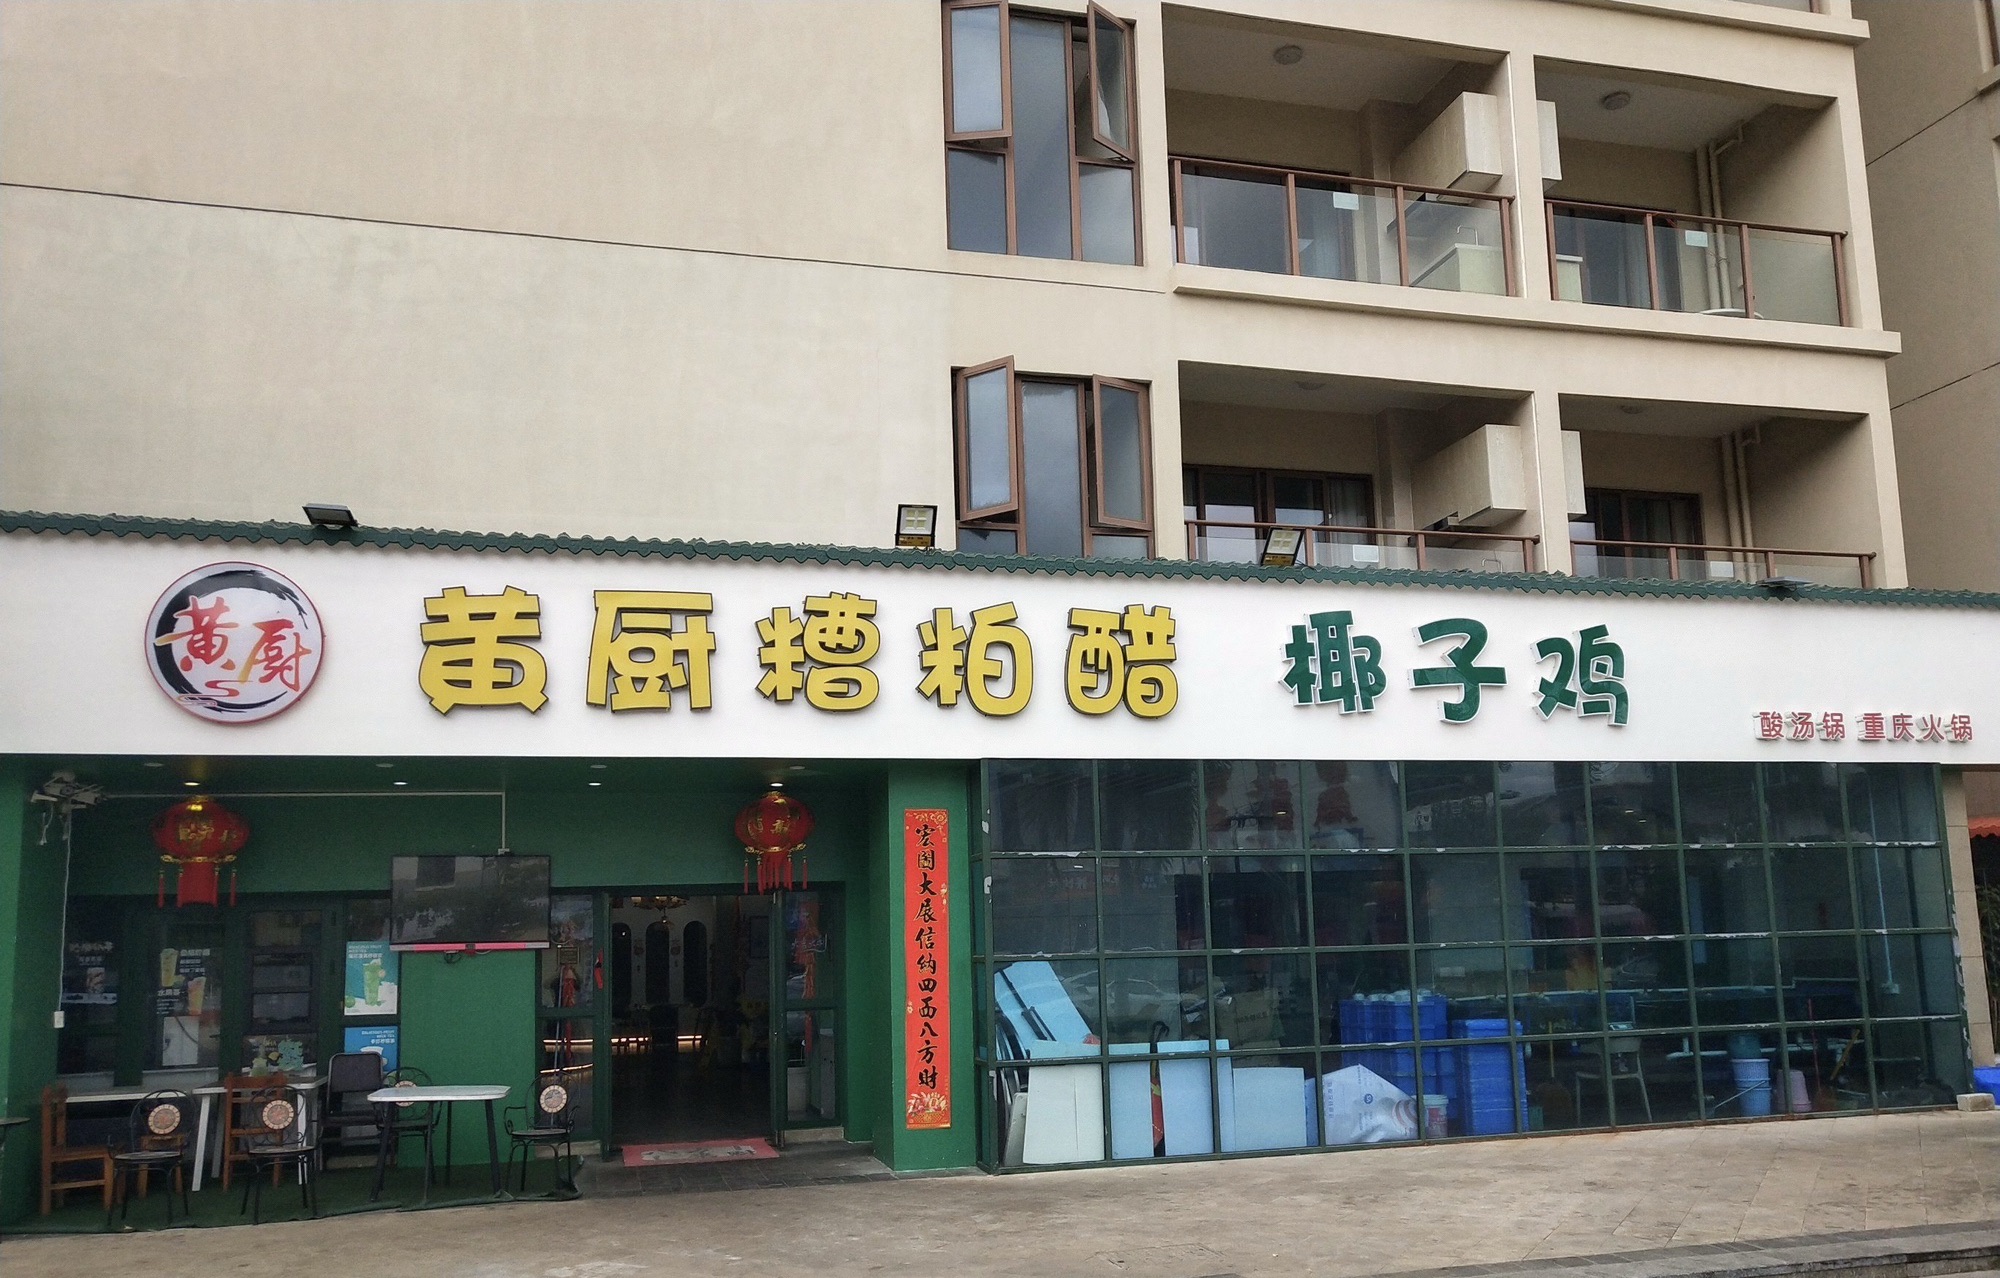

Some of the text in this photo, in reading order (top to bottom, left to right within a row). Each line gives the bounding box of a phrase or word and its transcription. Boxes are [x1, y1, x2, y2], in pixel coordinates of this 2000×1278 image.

[154, 595, 312, 693] 黄厨
[418, 584, 1179, 720] 黄厨糟粕醋
[1279, 610, 1630, 727] 椰子鸡
[1758, 711, 1974, 741] 酸汤锅 重庆火锅
